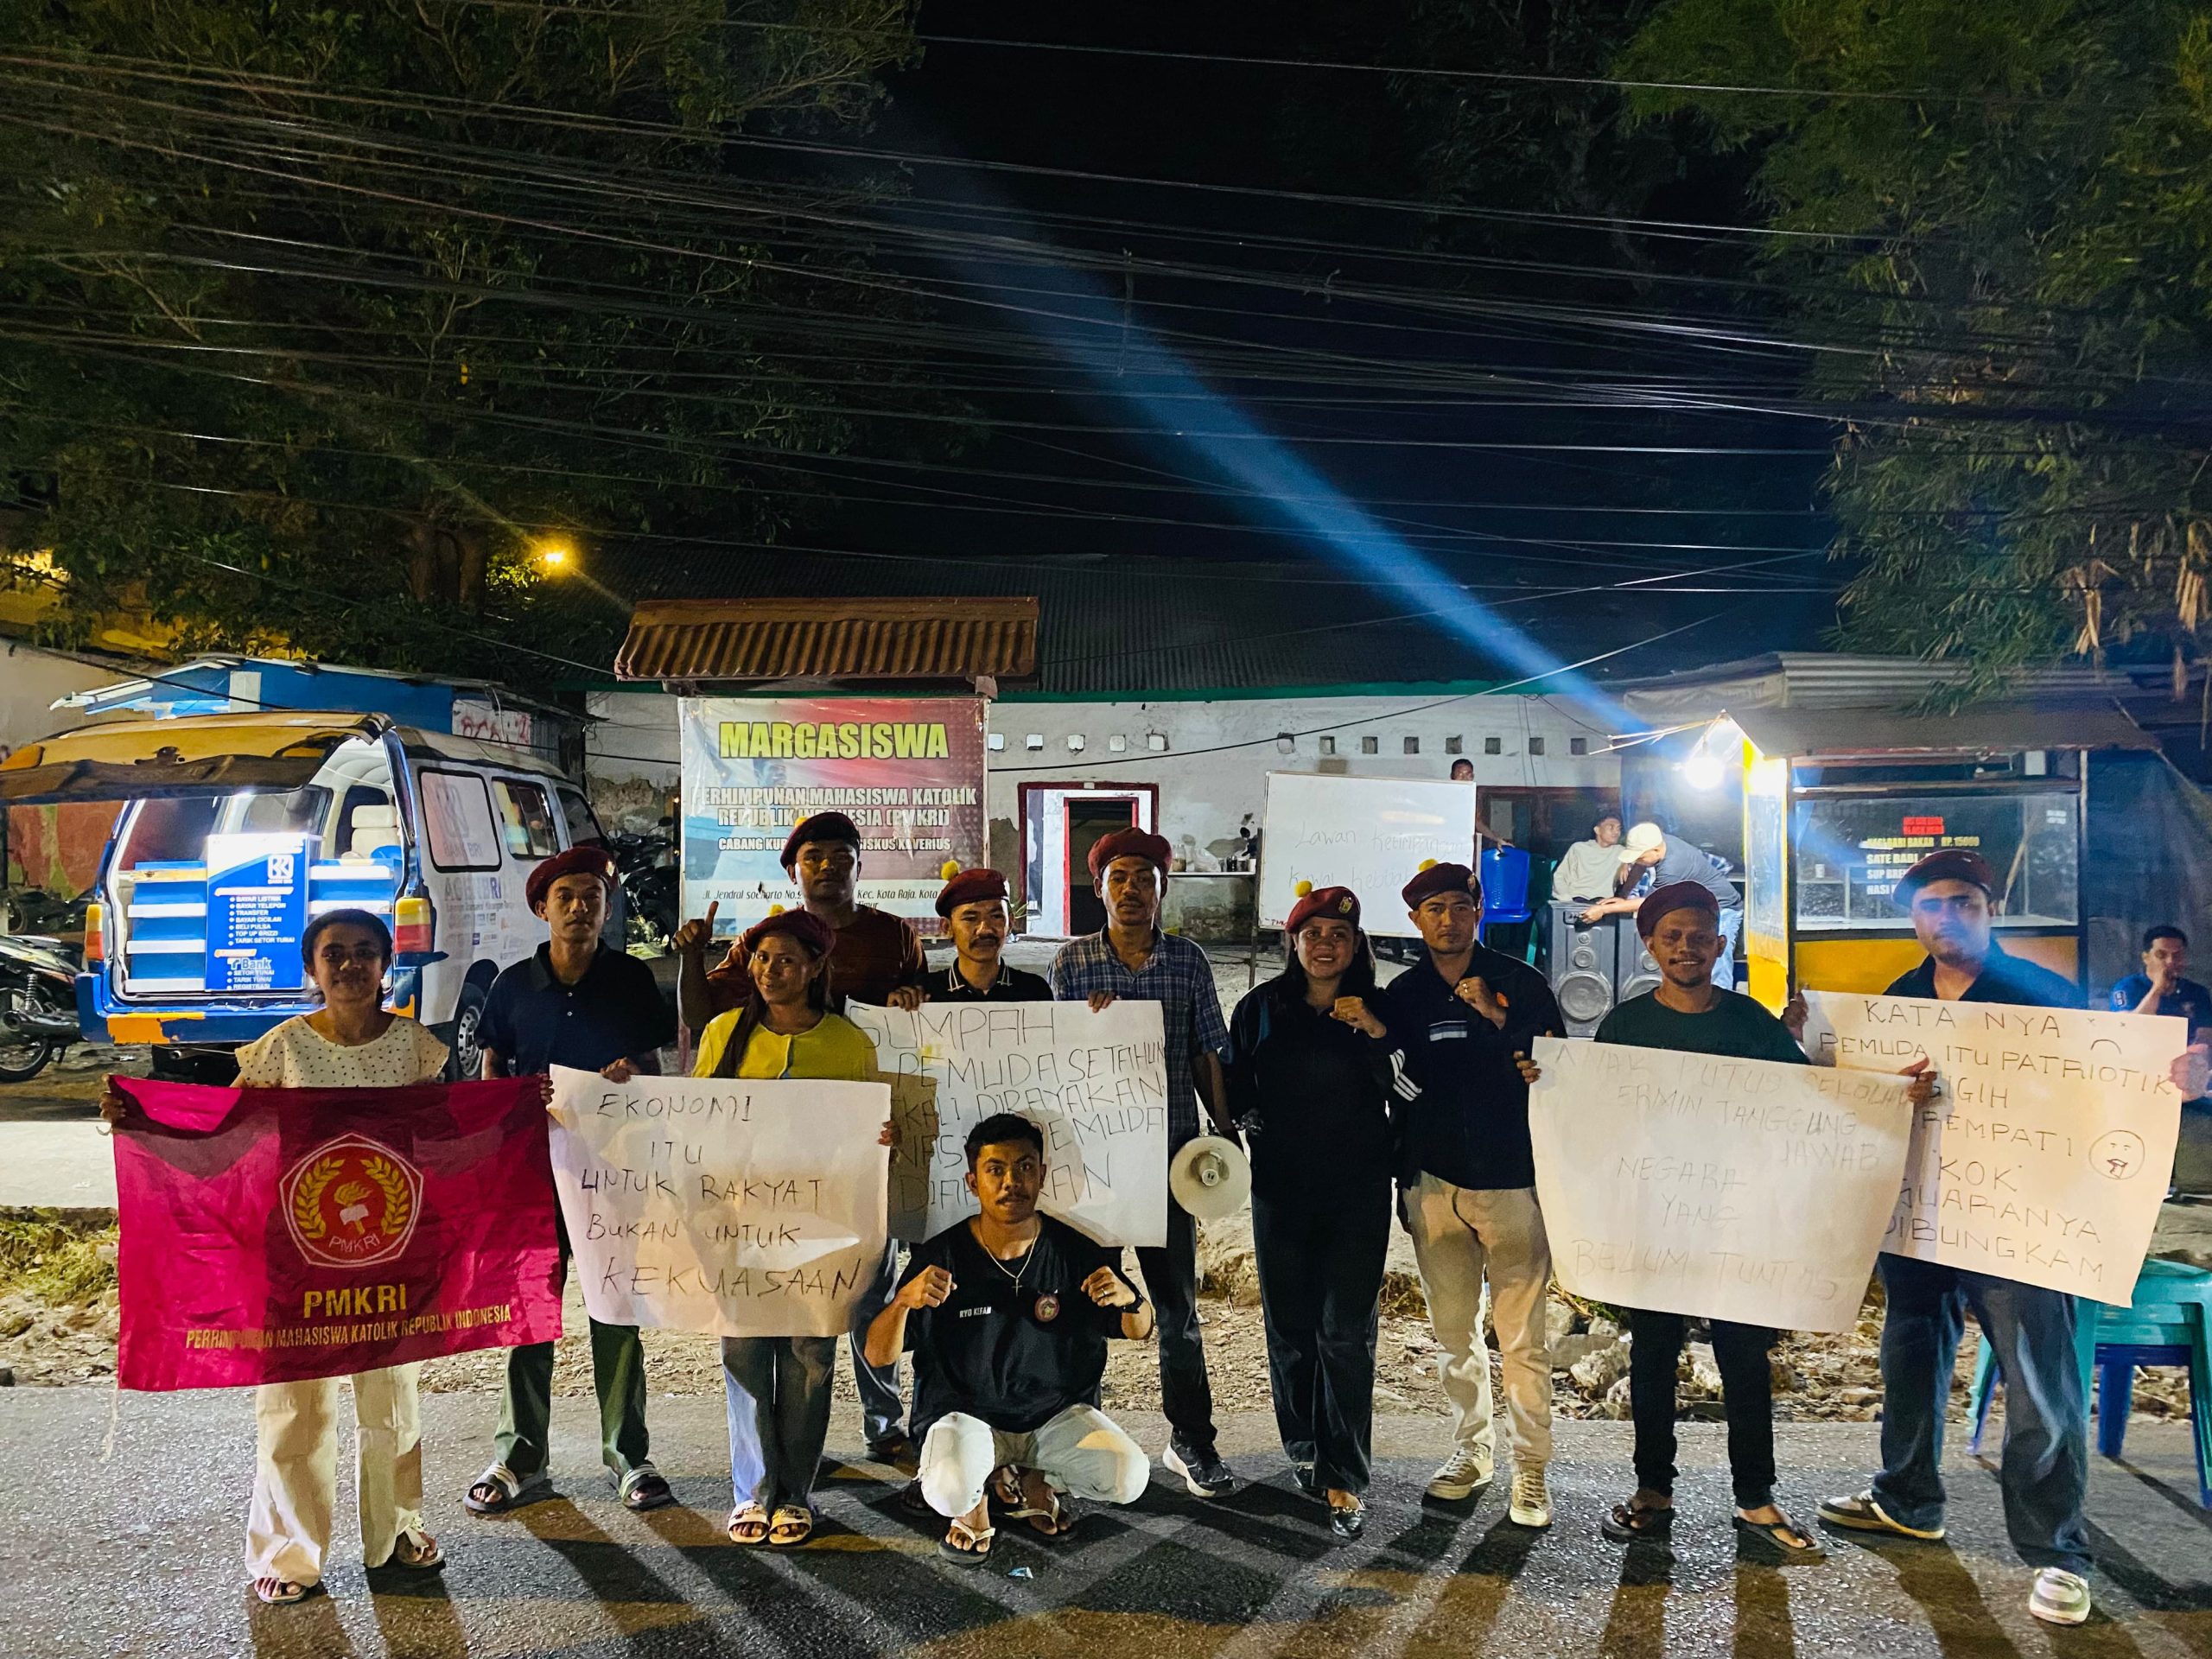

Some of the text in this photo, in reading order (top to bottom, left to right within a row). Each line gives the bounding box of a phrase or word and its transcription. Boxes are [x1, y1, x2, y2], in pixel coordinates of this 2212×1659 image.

[719, 722, 949, 759] MARGASISWA
[692, 787, 976, 805] PERHIMPUNAN MAHASISWA KATOLIK
[718, 808, 794, 826] REPUBLIK
[1295, 821, 1357, 849] Lawan
[718, 837, 764, 851] CABANG
[898, 838, 950, 851] XAVERIUS
[715, 890, 744, 899] Jendral
[857, 889, 874, 899] Kec.
[877, 889, 895, 899] Kota
[918, 889, 938, 899] Kota
[849, 1005, 1055, 1051] SUMPAH
[1864, 1000, 2061, 1038] KATA NYA
[897, 1052, 1059, 1090] PEMUDA
[1820, 1032, 2173, 1096] PEMUDA ITU PATRIOTIK
[597, 1093, 752, 1122] EKONOMI
[891, 1096, 961, 1130] KALI
[651, 1141, 702, 1165] ITU
[582, 1168, 823, 1215] UNTUK RAKYAT
[1618, 1156, 1747, 1192] NEGARA
[1938, 1155, 2018, 1192] KOK
[1662, 1194, 1740, 1230] YANG
[327, 1234, 380, 1254] PMKRI
[586, 1213, 802, 1249] BUKAN UNTUK
[601, 1257, 861, 1300] KEKUASAAN
[303, 1284, 407, 1319] PMKRI
[959, 1309, 972, 1319] RYO
[276, 1324, 348, 1347] MAHASISWA
[351, 1320, 398, 1344] KATOLIK
[401, 1313, 453, 1338] REPUBLIK
[455, 1305, 512, 1330] INDONESIA
